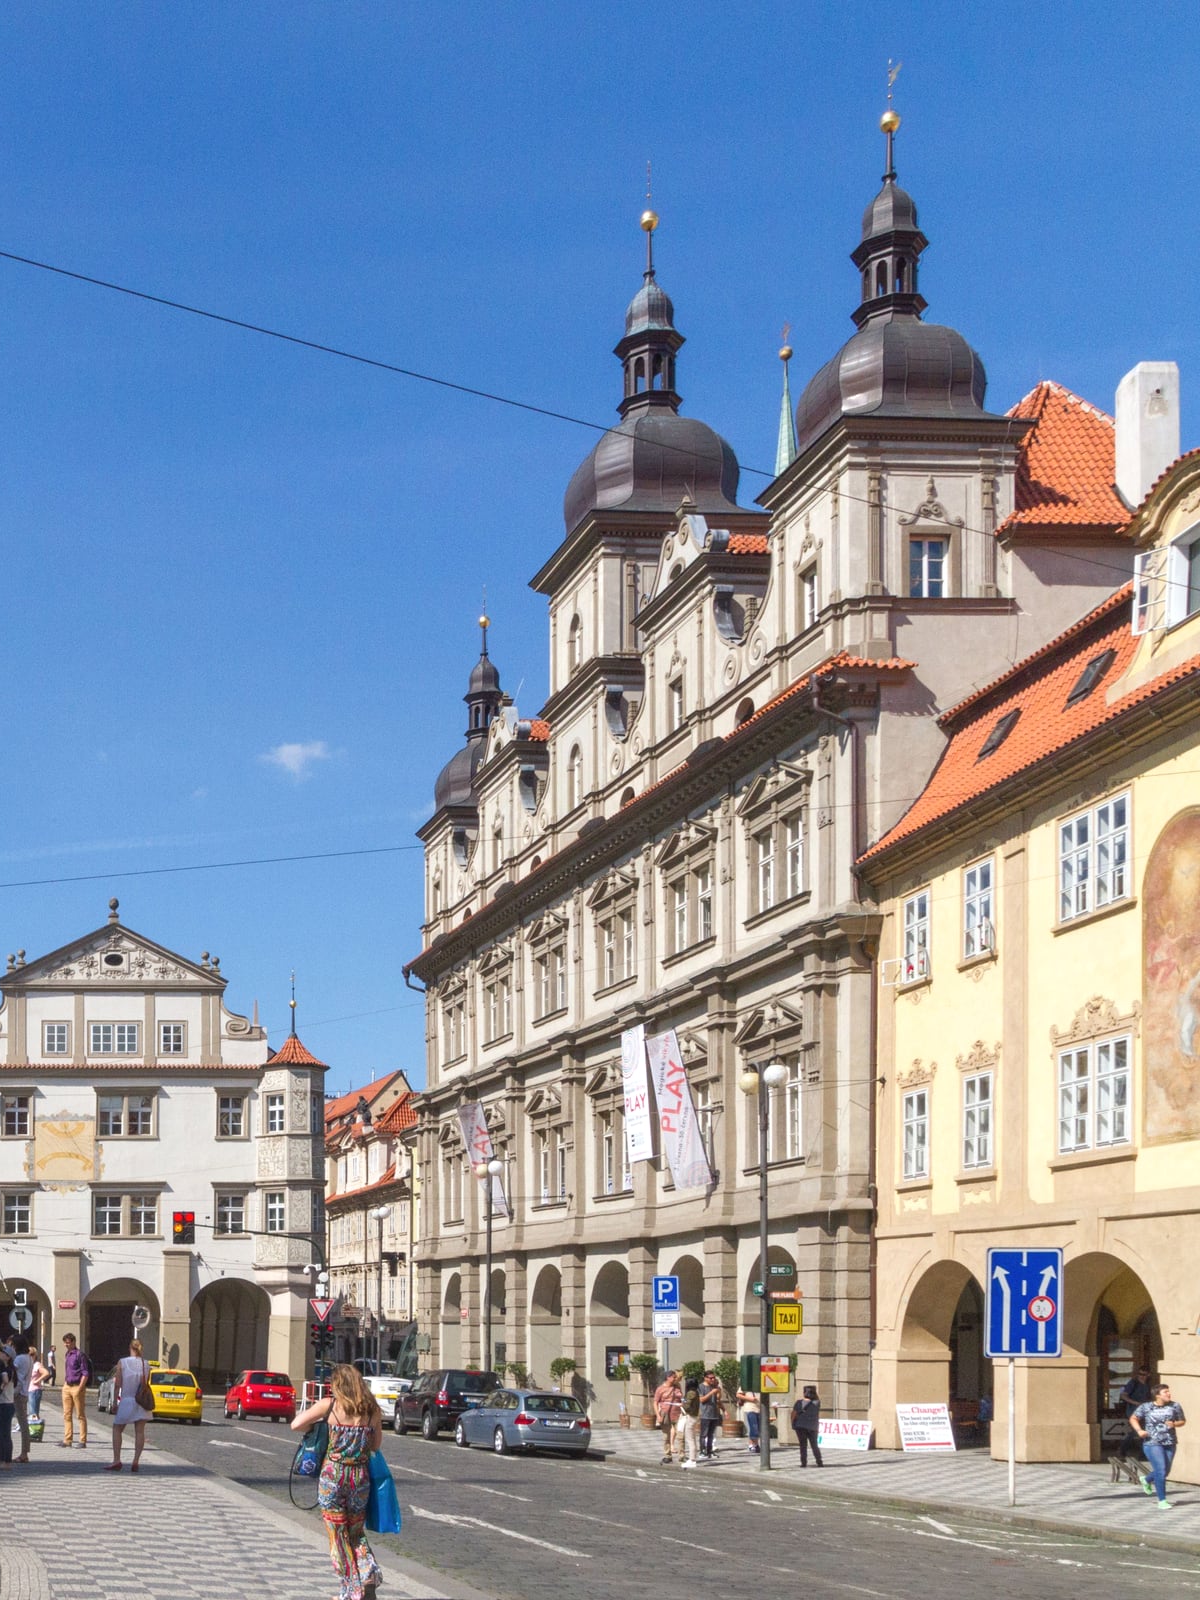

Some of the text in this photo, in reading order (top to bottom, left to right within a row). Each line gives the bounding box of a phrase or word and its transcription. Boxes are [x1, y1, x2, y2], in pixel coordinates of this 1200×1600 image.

[625, 1092, 646, 1113] PLAY
[661, 1059, 686, 1133] PLAY
[658, 1280, 673, 1301] P
[779, 1313, 797, 1325] TAXI
[911, 1406, 946, 1415] Change?
